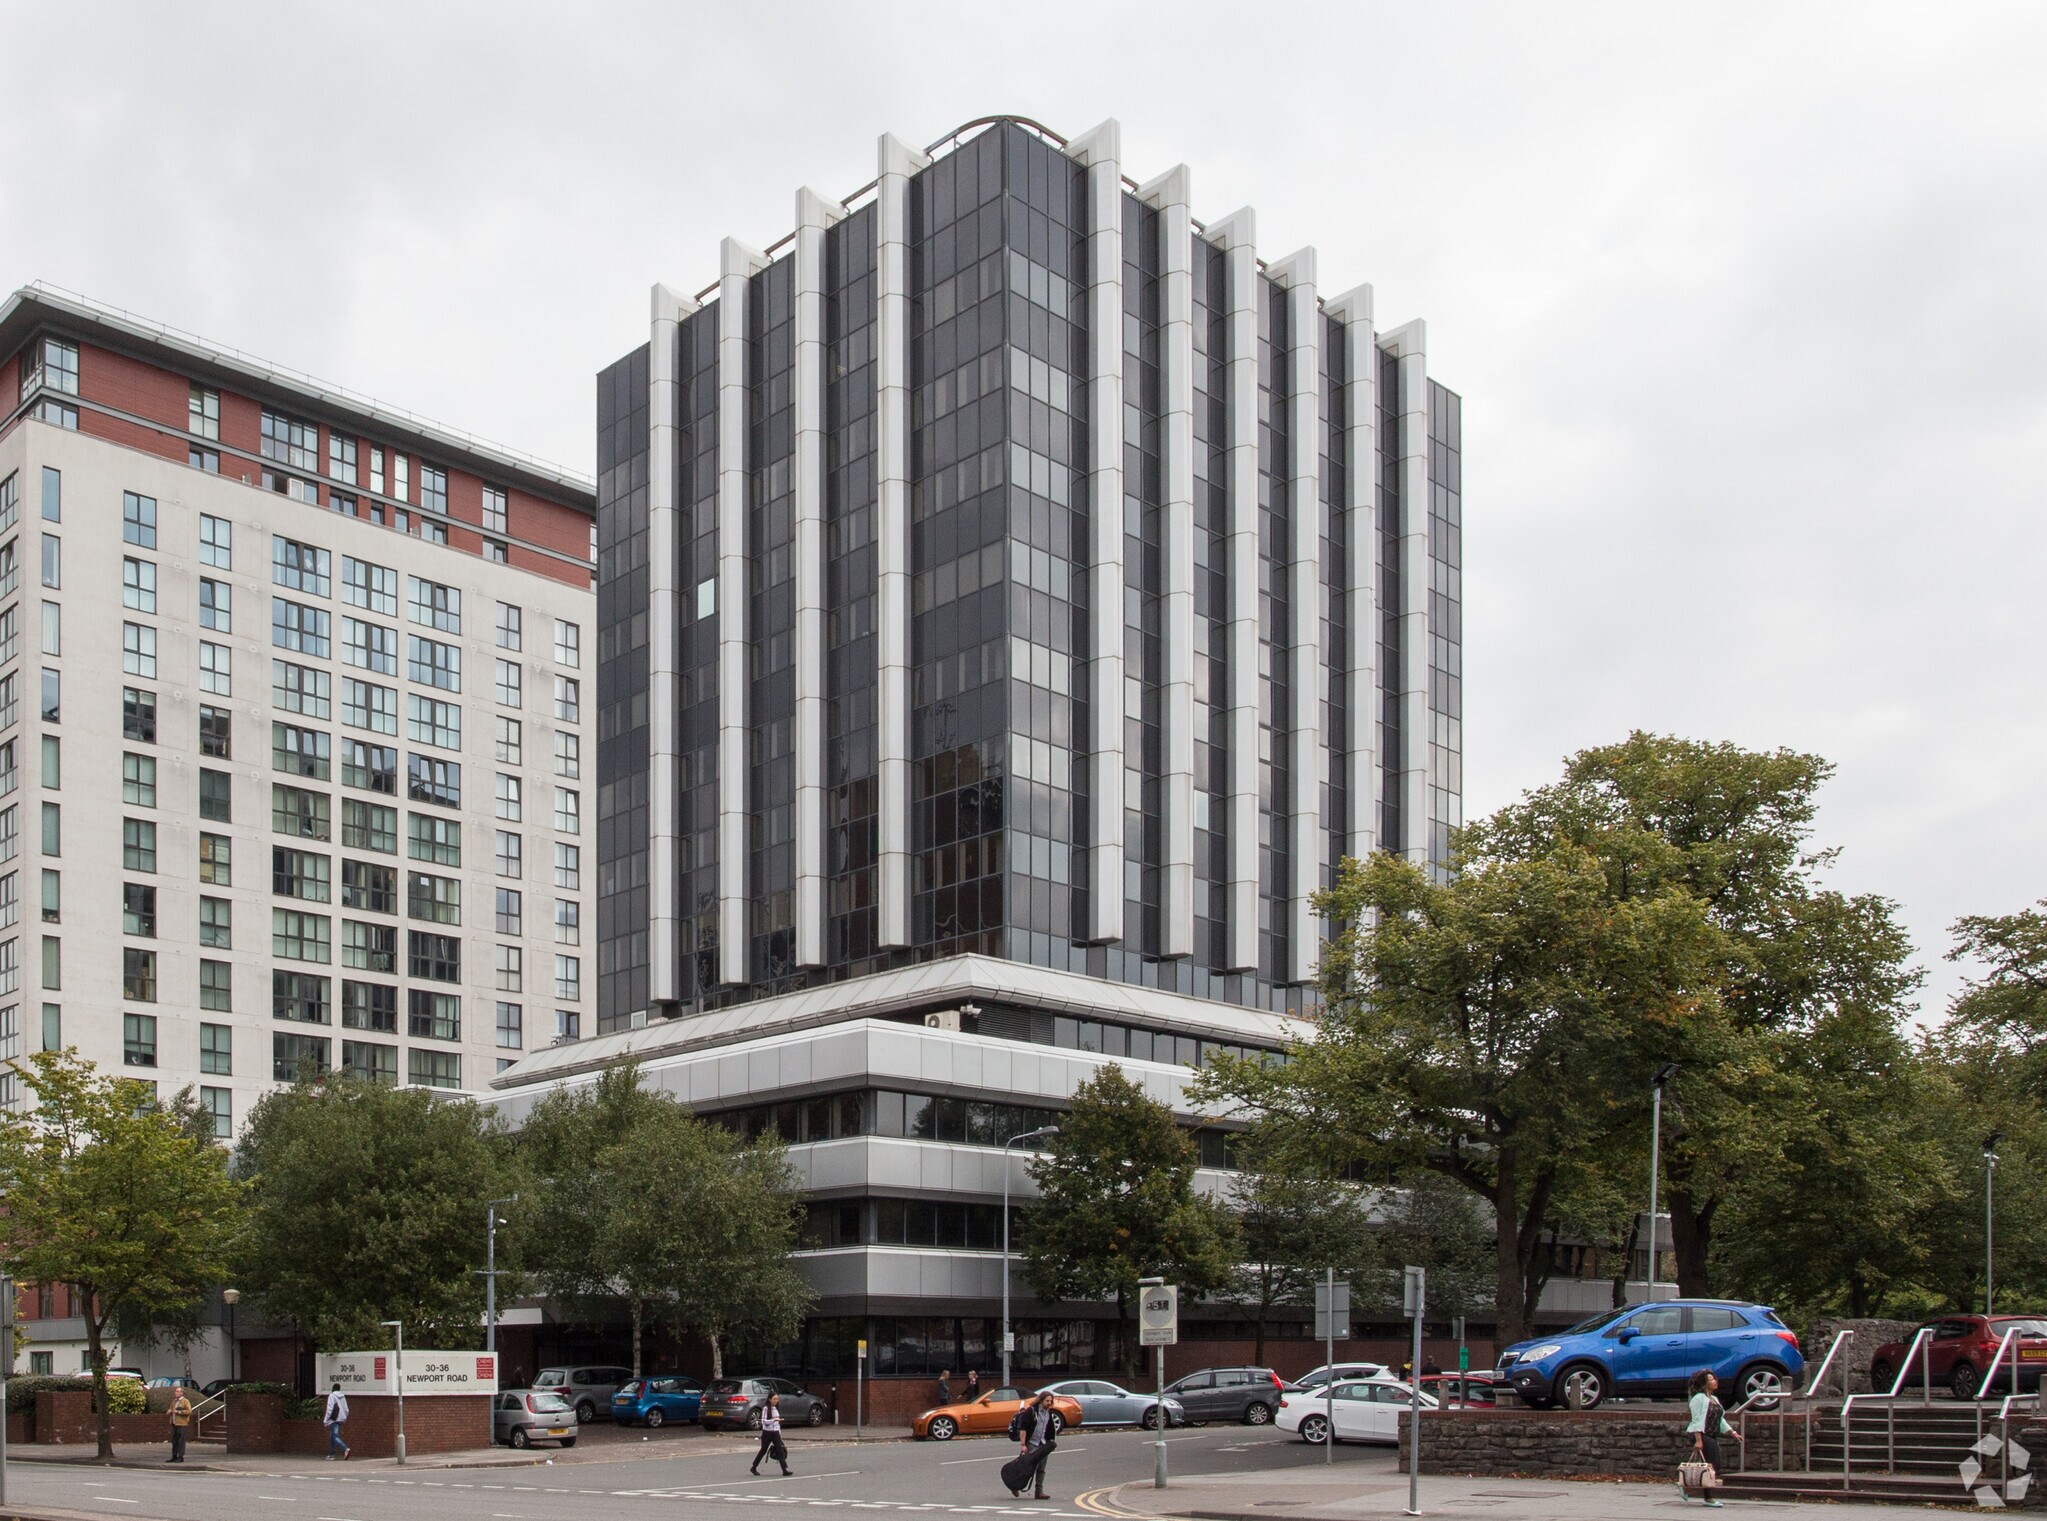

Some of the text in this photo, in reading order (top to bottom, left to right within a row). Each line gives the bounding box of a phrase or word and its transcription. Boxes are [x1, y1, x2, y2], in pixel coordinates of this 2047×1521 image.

[340, 1364, 355, 1372] 30-36
[425, 1364, 449, 1372] 30-36
[329, 1374, 352, 1382] NEWPORT
[353, 1374, 366, 1382] ROAD
[406, 1374, 444, 1382] NEWPORT
[446, 1374, 468, 1382] ROAD
